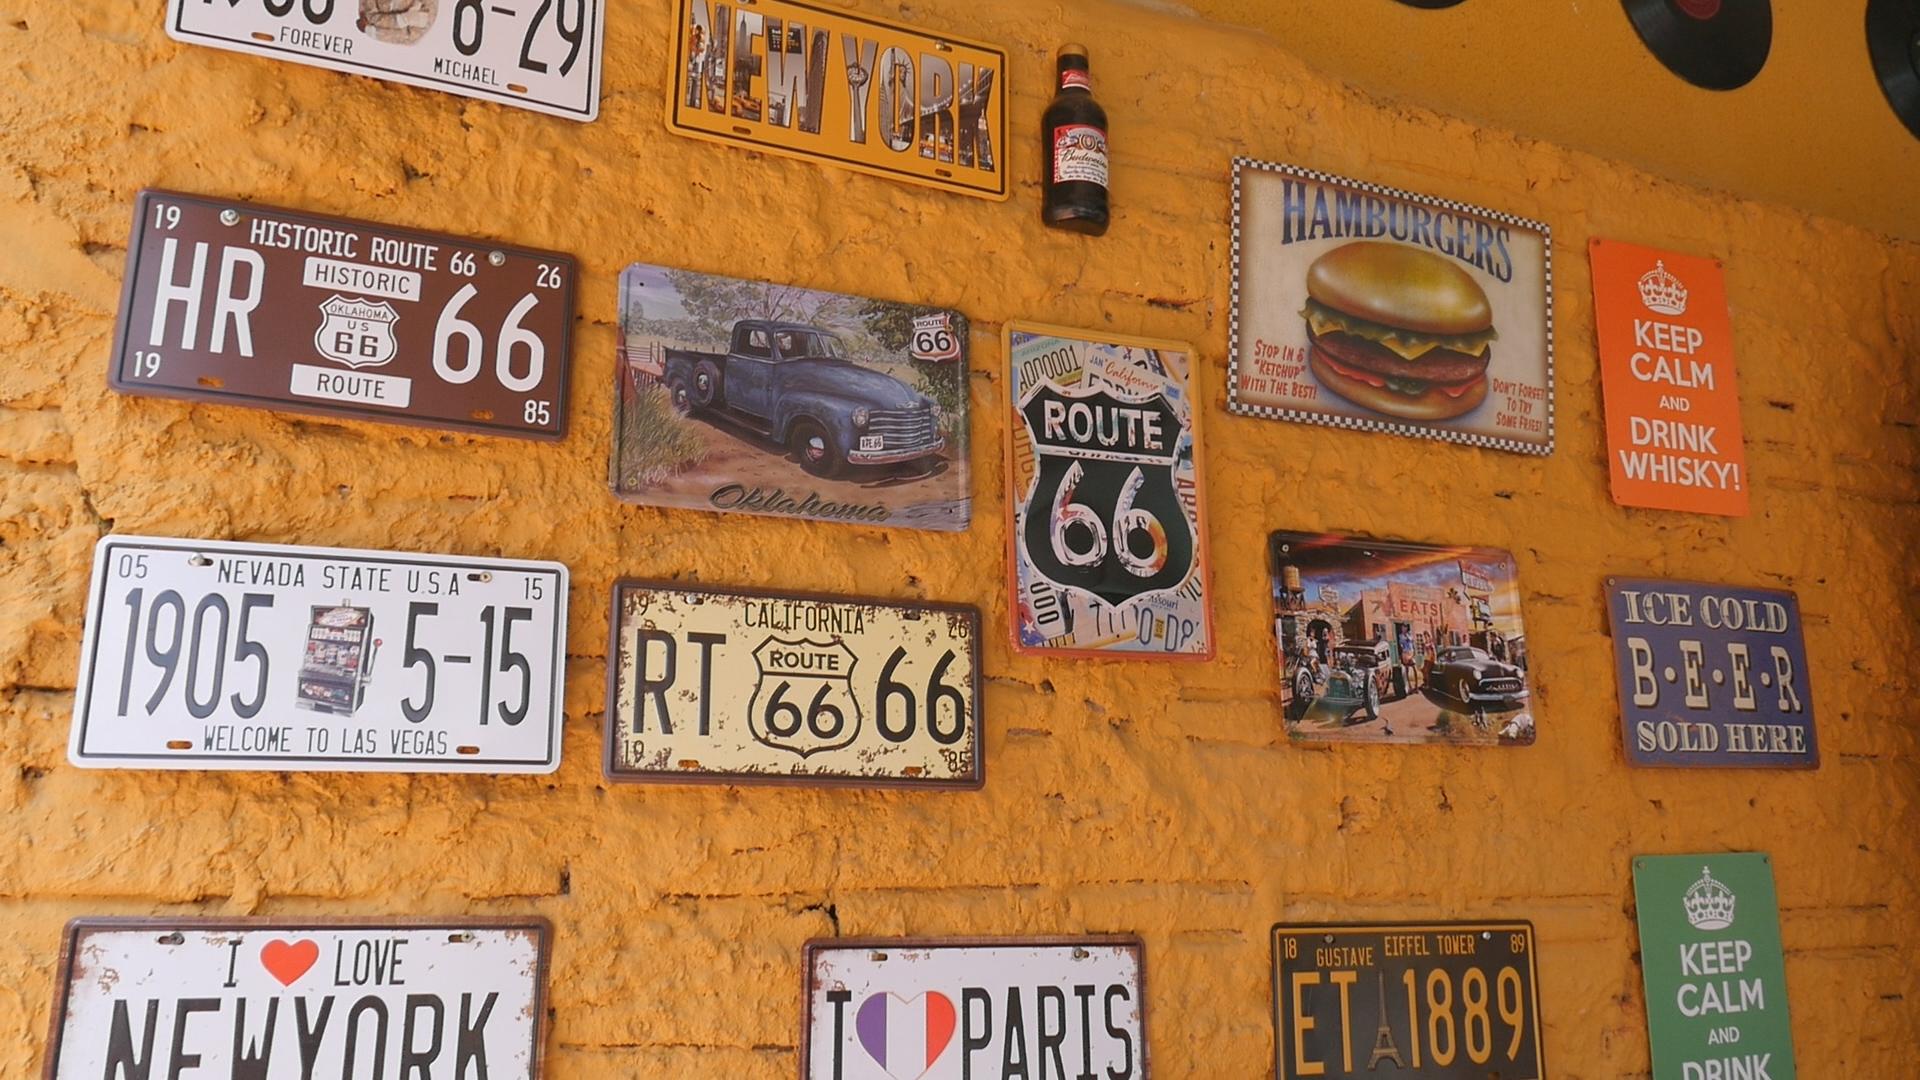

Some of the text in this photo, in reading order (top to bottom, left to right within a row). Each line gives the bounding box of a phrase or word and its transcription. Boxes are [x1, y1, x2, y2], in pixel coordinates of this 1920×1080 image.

[279, 26, 353, 55] FOREVER
[433, 57, 499, 86] MICHAEL
[685, 0, 996, 172] NEW YORK
[154, 203, 181, 230] 19
[1281, 178, 1513, 283] HAMBURGERS
[250, 218, 477, 277] HISTORIC ROUTE 66
[315, 264, 411, 295] HISTORIC
[536, 264, 562, 290] 26
[149, 237, 266, 358] HR
[330, 303, 388, 320] OKLAHOMA
[432, 282, 545, 392] 66
[916, 319, 945, 327] ROUTE
[1633, 319, 1703, 354] KEEP
[334, 331, 378, 357] 66
[916, 330, 951, 353] 66
[1254, 338, 1280, 358] STOP
[1283, 346, 1294, 361] IN
[133, 350, 161, 379] 19
[1630, 352, 1714, 390] CALM
[316, 374, 386, 400] ROUTE
[1241, 374, 1317, 400] WITH THE BEST!
[1659, 395, 1690, 412] AND
[524, 400, 550, 426] 85
[1044, 399, 1164, 450] ROUTE
[1630, 416, 1718, 454] DRINK
[1619, 449, 1741, 491] WHISKY!
[709, 484, 892, 521] Oklahoma
[1050, 459, 1168, 578] 66
[119, 554, 149, 580] 05
[217, 558, 305, 588] NEVADA
[322, 565, 391, 593] STATE
[524, 577, 544, 601] 15
[744, 601, 865, 636] CALIFORNIA
[1400, 599, 1438, 616] EATS
[1621, 590, 1788, 633] ICE COLD
[117, 587, 275, 720] 1905
[400, 601, 533, 727] 5-15
[769, 649, 840, 672] ROUTE
[632, 628, 727, 736] RT
[875, 645, 966, 745] 66
[764, 680, 845, 739] 66
[204, 725, 448, 756] WELCOME TO LAS VEGAS
[1637, 720, 1807, 754] SOLD HERE
[1283, 937, 1297, 959] 18
[1316, 934, 1476, 968] GUSTAVE EIFFEL TOWER
[1510, 933, 1525, 954] 89
[1679, 940, 1752, 976] KEEP
[223, 939, 409, 988] I LOVE
[1677, 978, 1764, 1017] CALM
[961, 983, 1133, 1080] PARIS
[1292, 970, 1357, 1075] ET
[1402, 966, 1524, 1068] 1889
[1708, 1026, 1740, 1045] AND
[1682, 1053, 1773, 1080] DRINK
